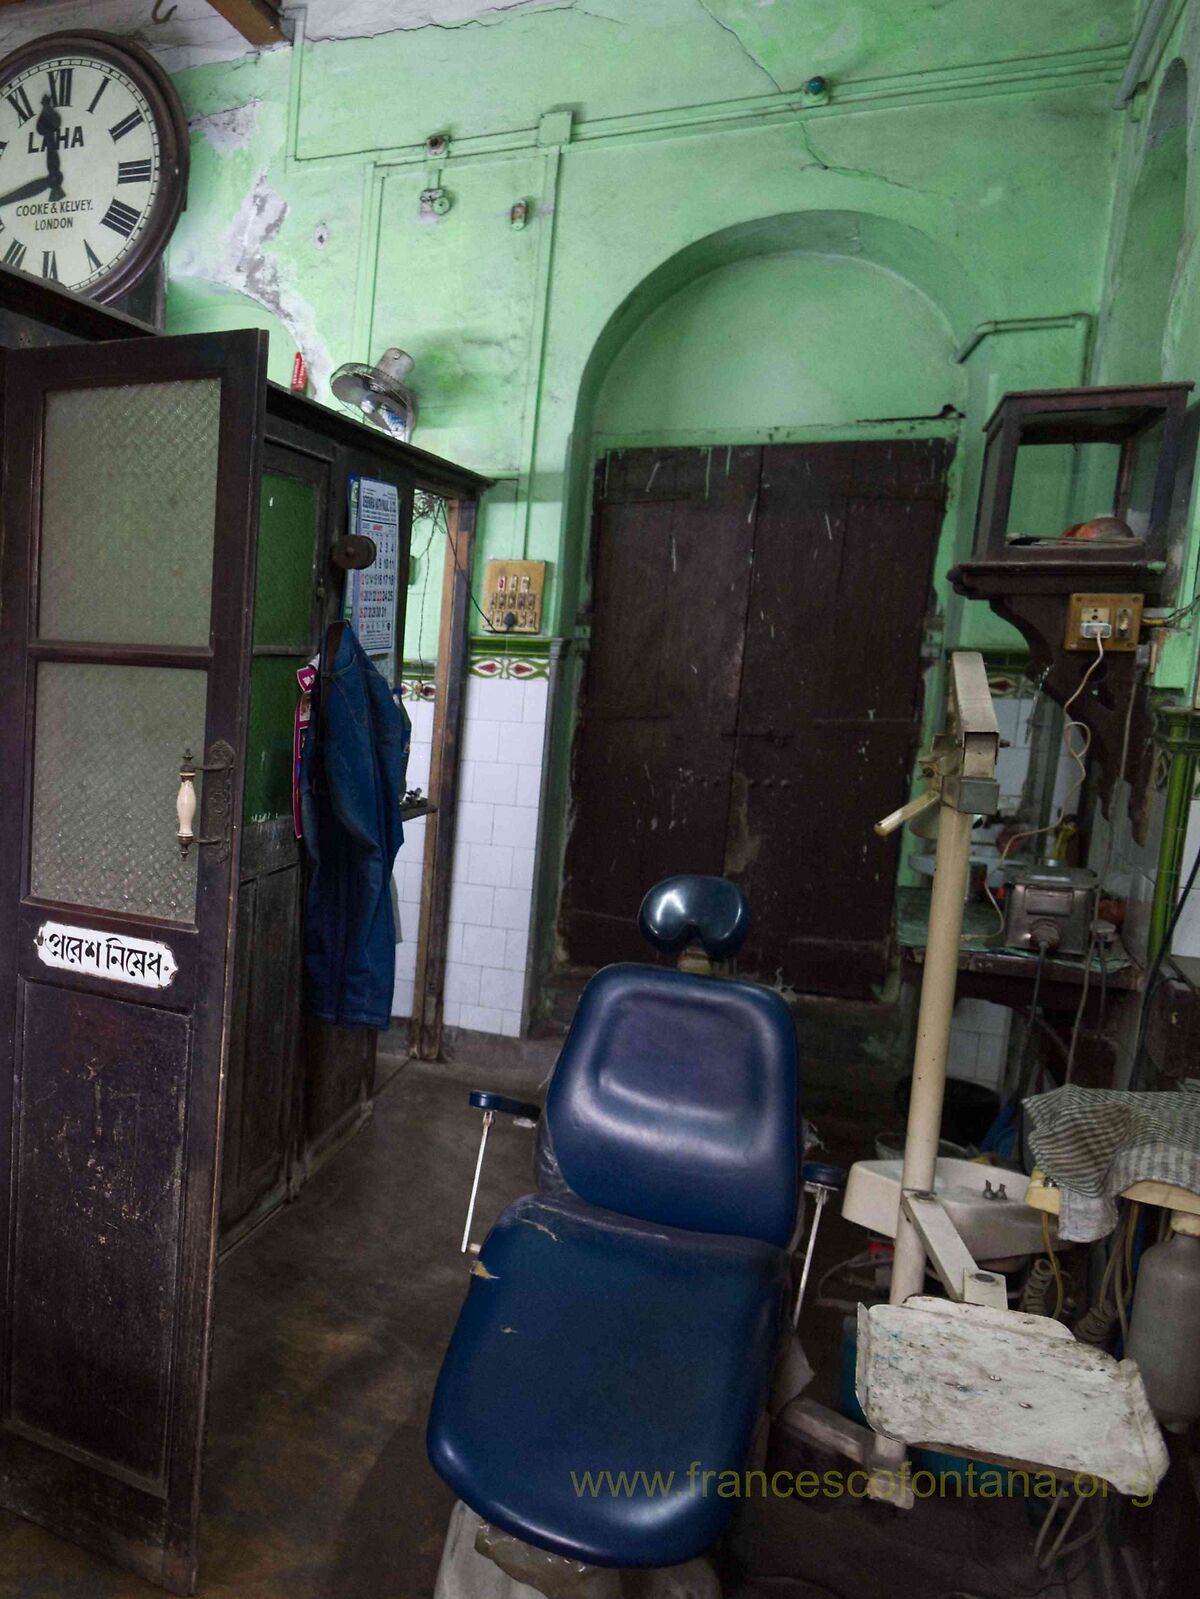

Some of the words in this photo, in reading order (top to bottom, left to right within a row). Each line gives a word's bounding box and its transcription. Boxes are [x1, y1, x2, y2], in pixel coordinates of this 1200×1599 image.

[16, 203, 49, 217] COOKE
[50, 203, 58, 214] &
[35, 217, 73, 231] LONDON
[48, 933, 101, 968] প্রবেশ
[105, 937, 162, 980] নিষেধ
